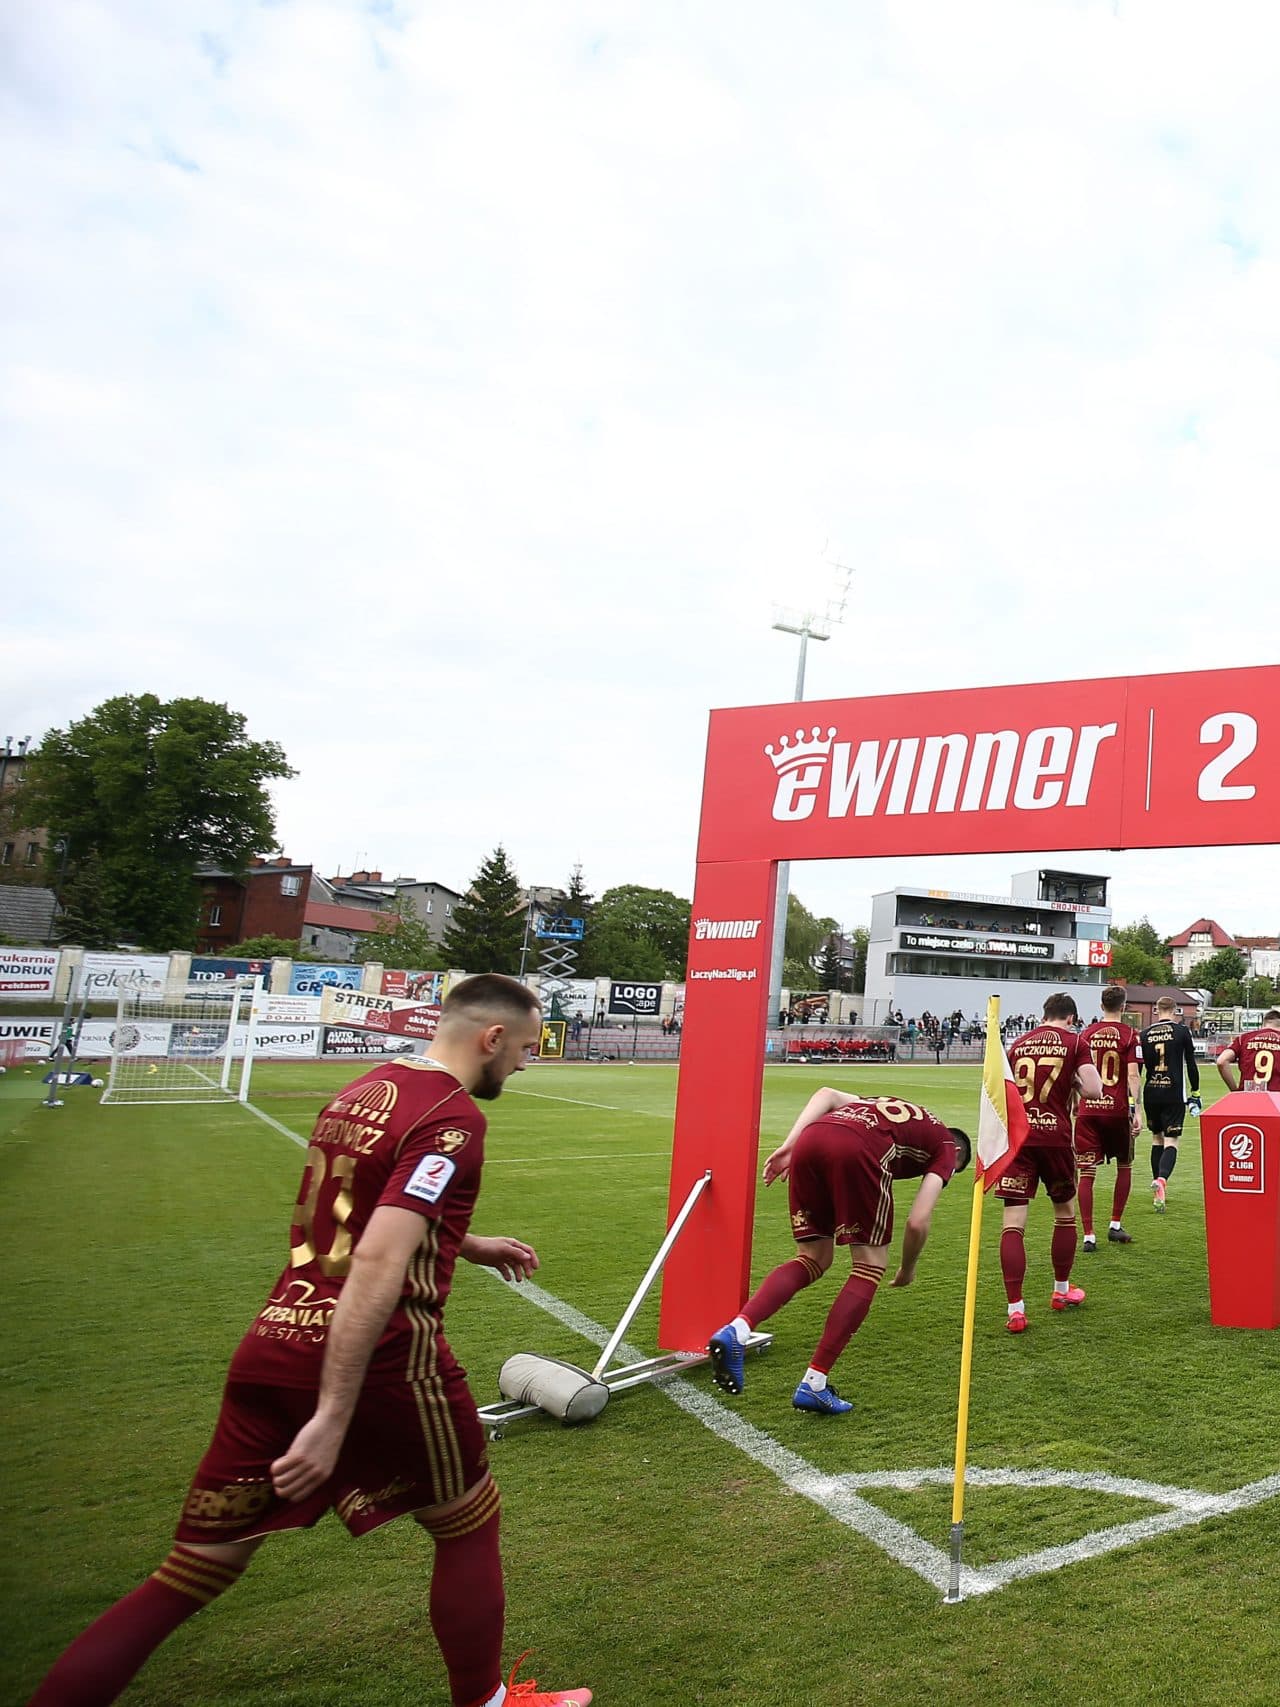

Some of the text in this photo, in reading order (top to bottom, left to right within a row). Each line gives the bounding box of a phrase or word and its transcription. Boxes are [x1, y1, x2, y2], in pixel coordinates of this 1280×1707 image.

[1198, 711, 1259, 802] 2
[1050, 902, 1091, 912] CHOJNICE
[905, 935, 917, 946] To
[918, 936, 950, 949] miejsce
[1091, 953, 1108, 964] 0:0
[690, 968, 757, 981] LaczyNas2liga.pl
[614, 986, 657, 999] LOGO
[334, 992, 394, 1011] STREFA
[1090, 1039, 1118, 1049] KONA
[1147, 1033, 1175, 1043] SOKÓŁ
[1014, 1045, 1068, 1056] RYCZKOWSKI
[1154, 1042, 1169, 1072] 1
[1253, 1049, 1275, 1084] 9
[1015, 1056, 1065, 1104] 97
[1229, 1161, 1254, 1170] 2 LIGA
